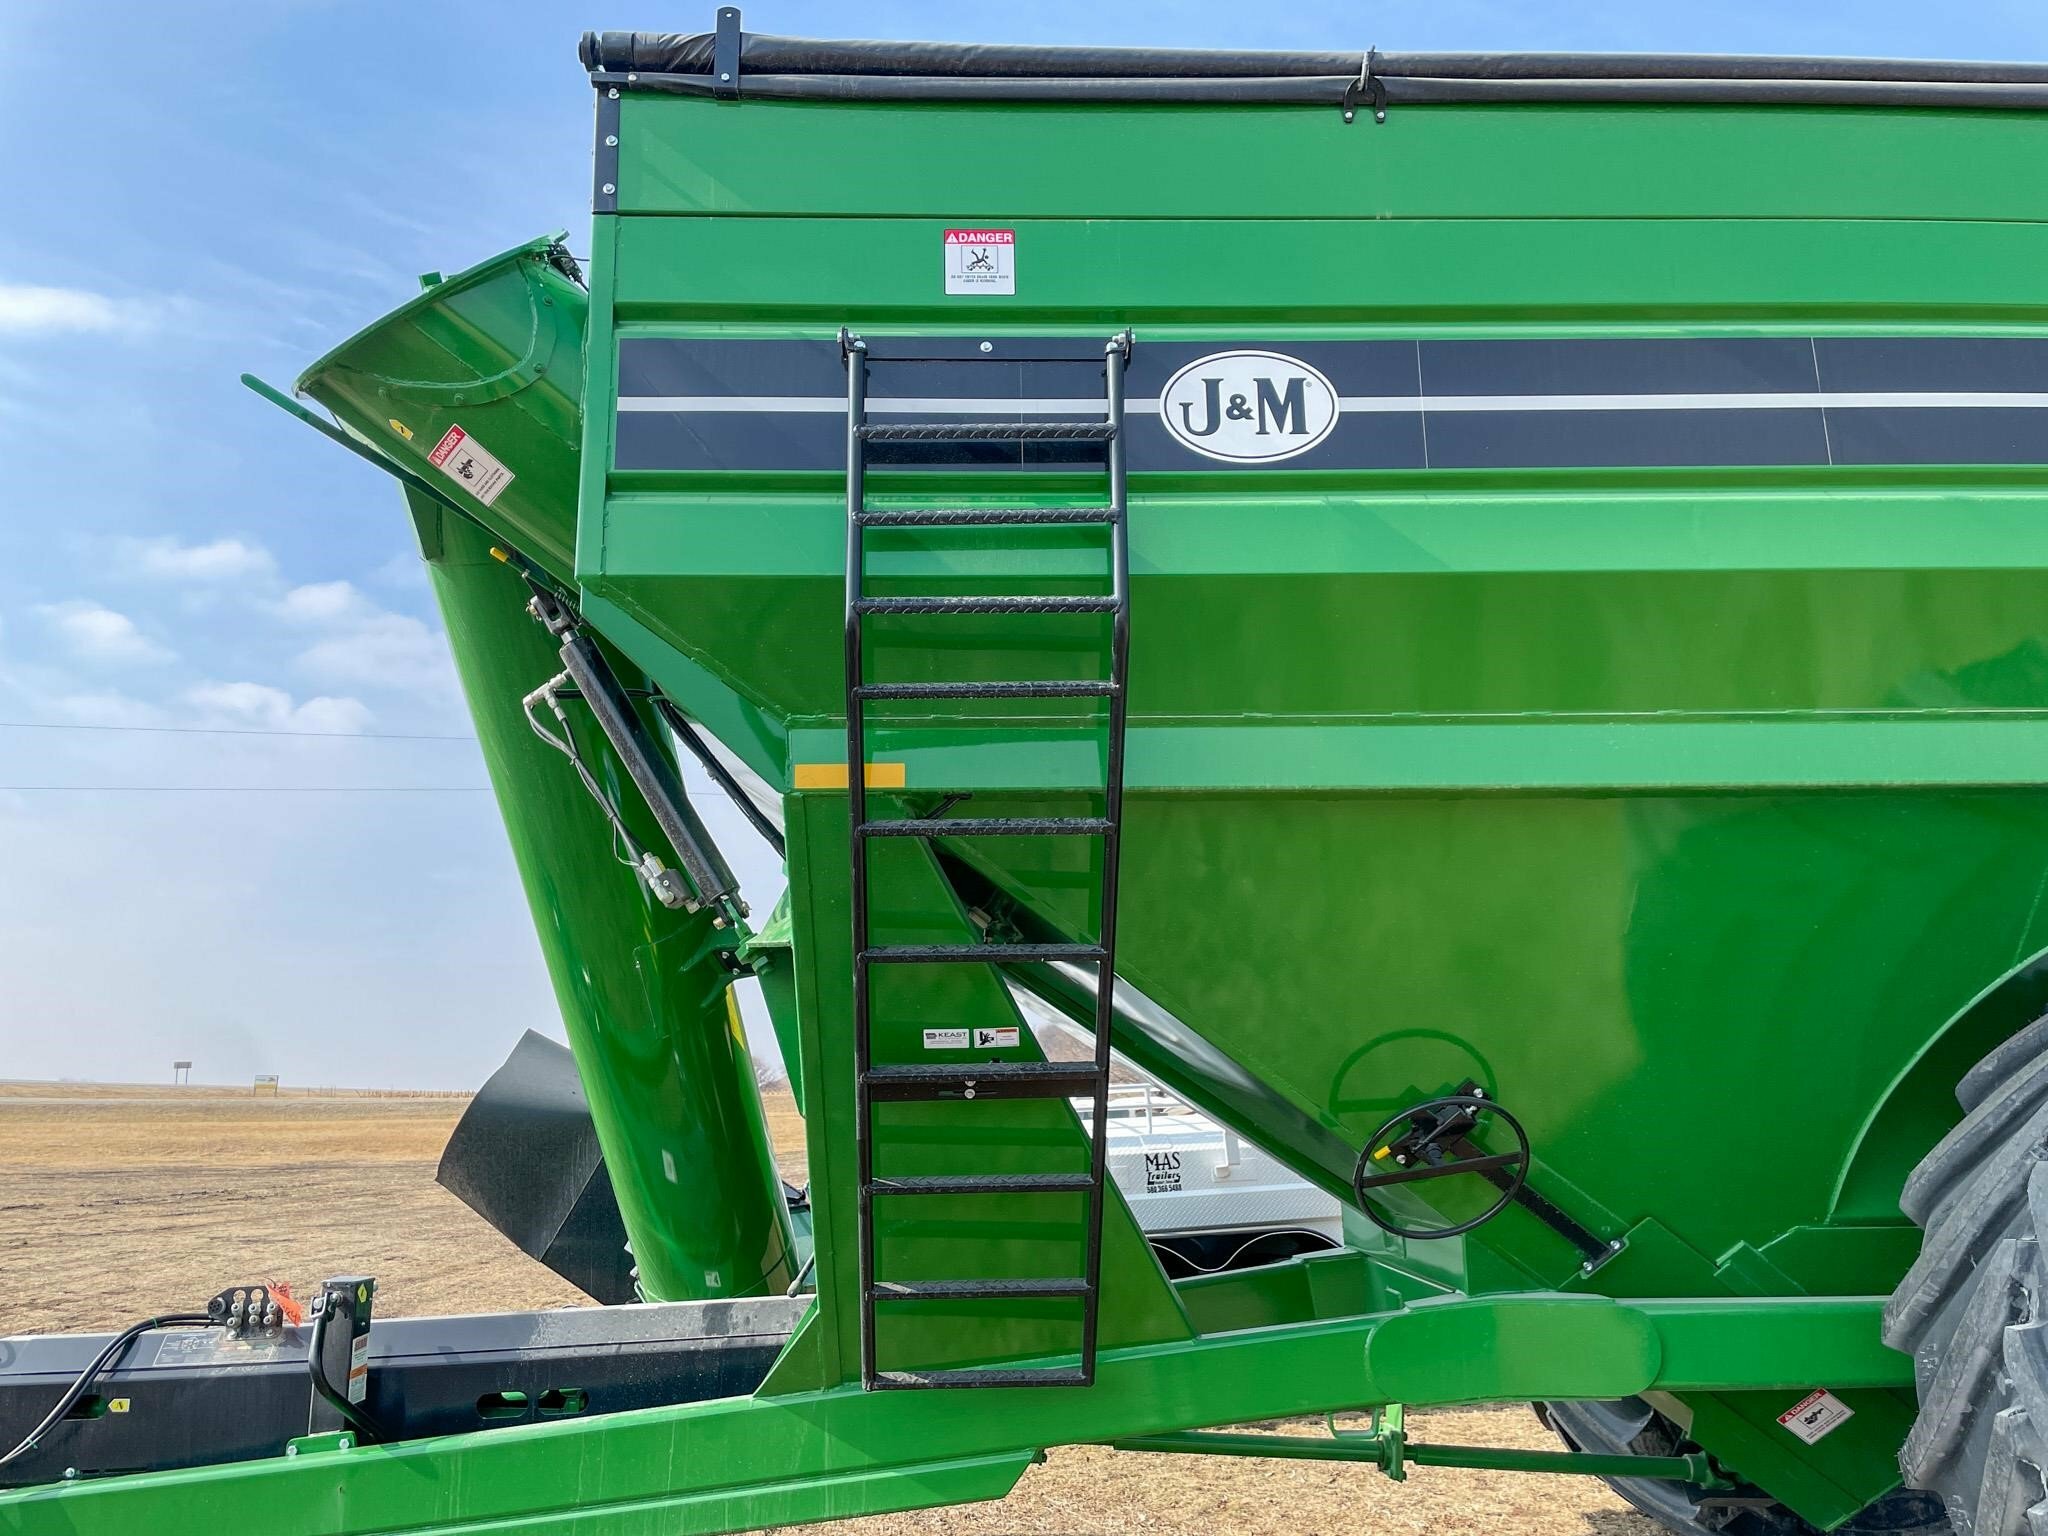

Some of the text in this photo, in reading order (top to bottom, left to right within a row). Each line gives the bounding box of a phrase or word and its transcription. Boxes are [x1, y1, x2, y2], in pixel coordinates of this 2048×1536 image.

[958, 233, 1013, 243] DANGER
[1179, 378, 1311, 436] J&M
[437, 431, 461, 461] DANGER
[1144, 1152, 1181, 1172] MAS
[1147, 1171, 1181, 1185] Trailers
[1791, 1392, 1822, 1415] DANGER
